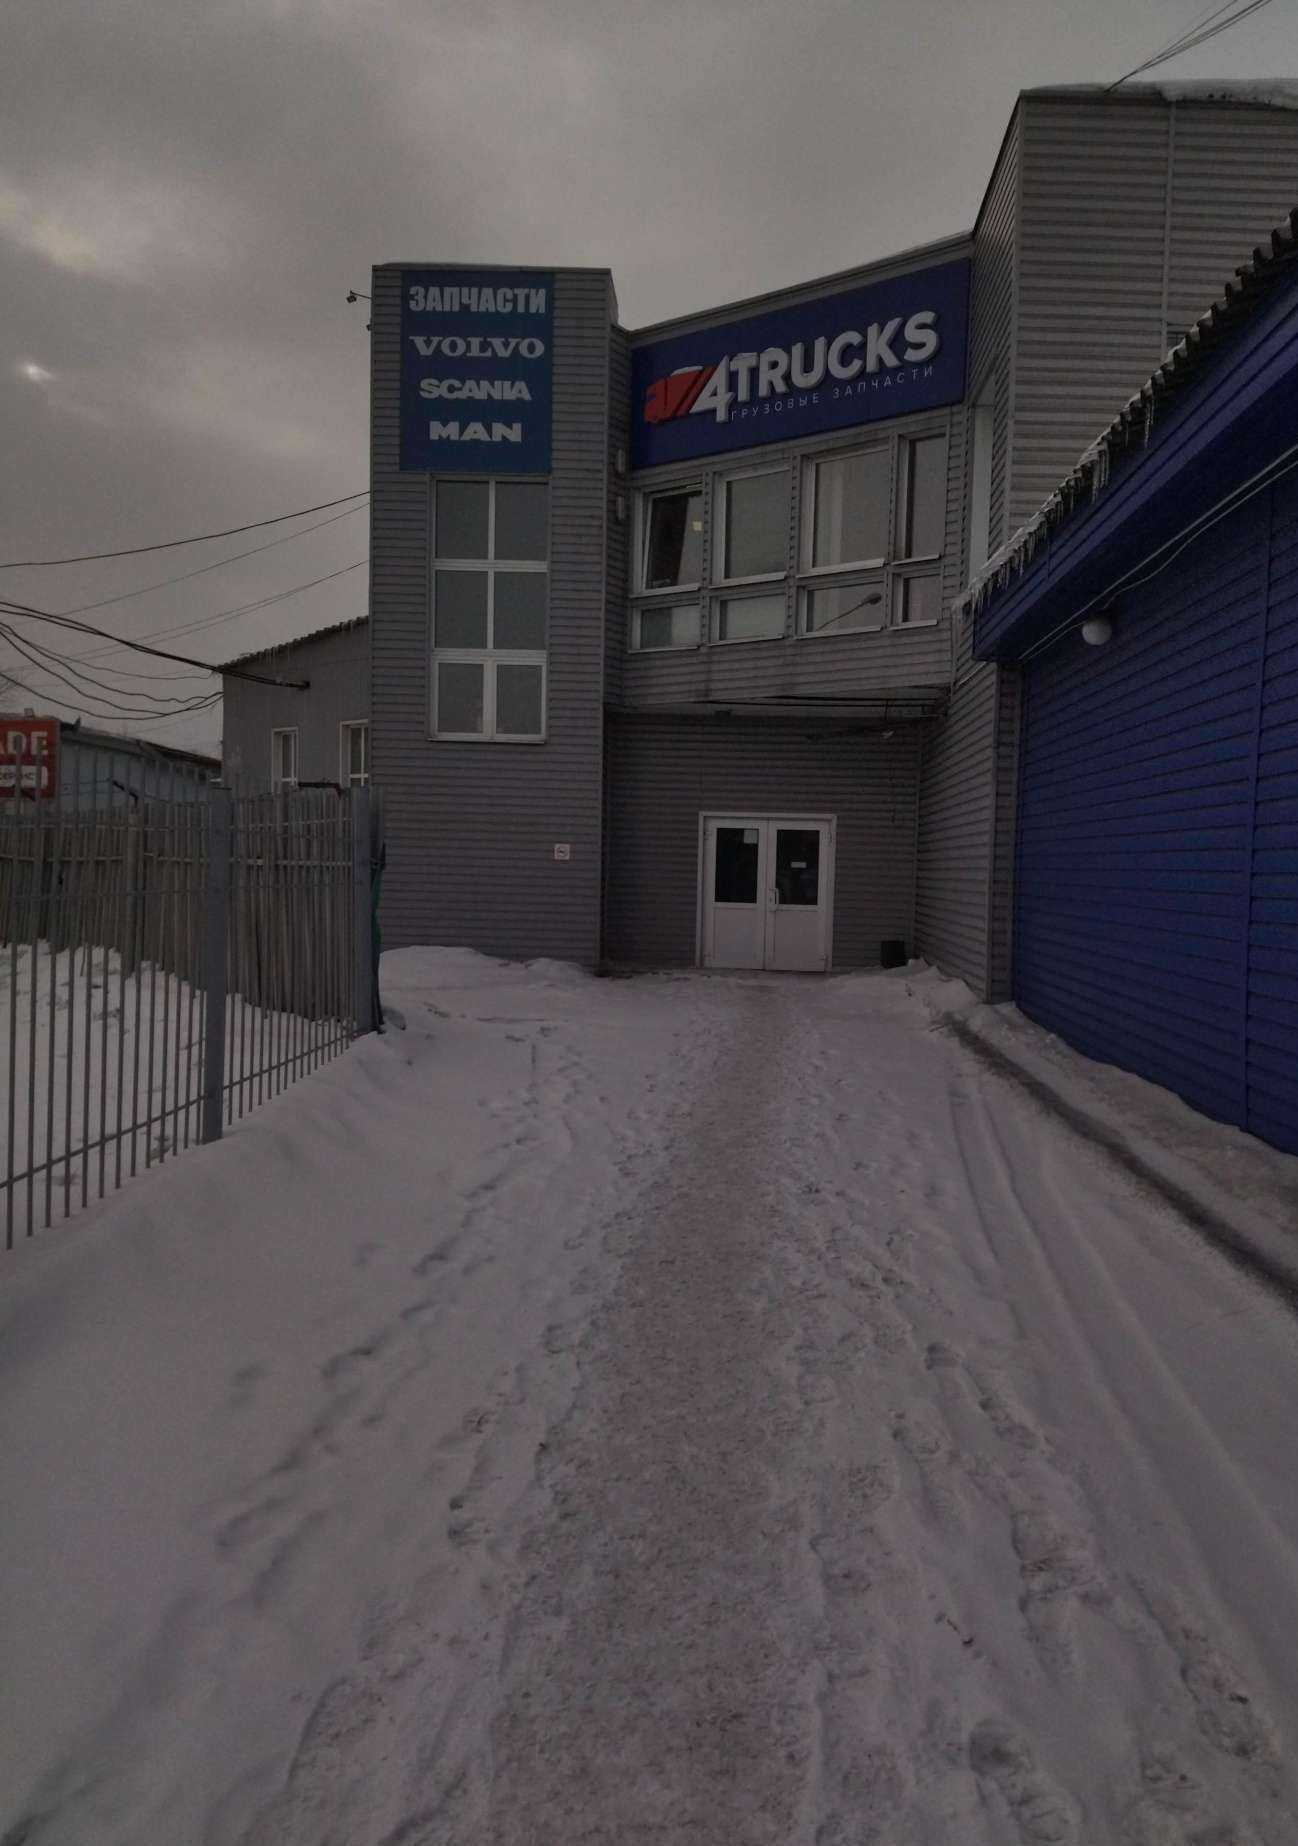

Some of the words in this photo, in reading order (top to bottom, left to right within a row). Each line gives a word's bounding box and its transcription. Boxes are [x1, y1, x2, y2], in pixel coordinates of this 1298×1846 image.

[409, 286, 546, 313] ЗАПЧАСТИ
[409, 336, 544, 358] VOLVO
[689, 310, 940, 424] 4TRUCKS
[419, 378, 532, 400] SCANIA
[730, 391, 820, 421] ГРУЗОВЫЕ
[832, 366, 934, 400] ЗАПЧАСТИ
[429, 421, 522, 442] MAN
